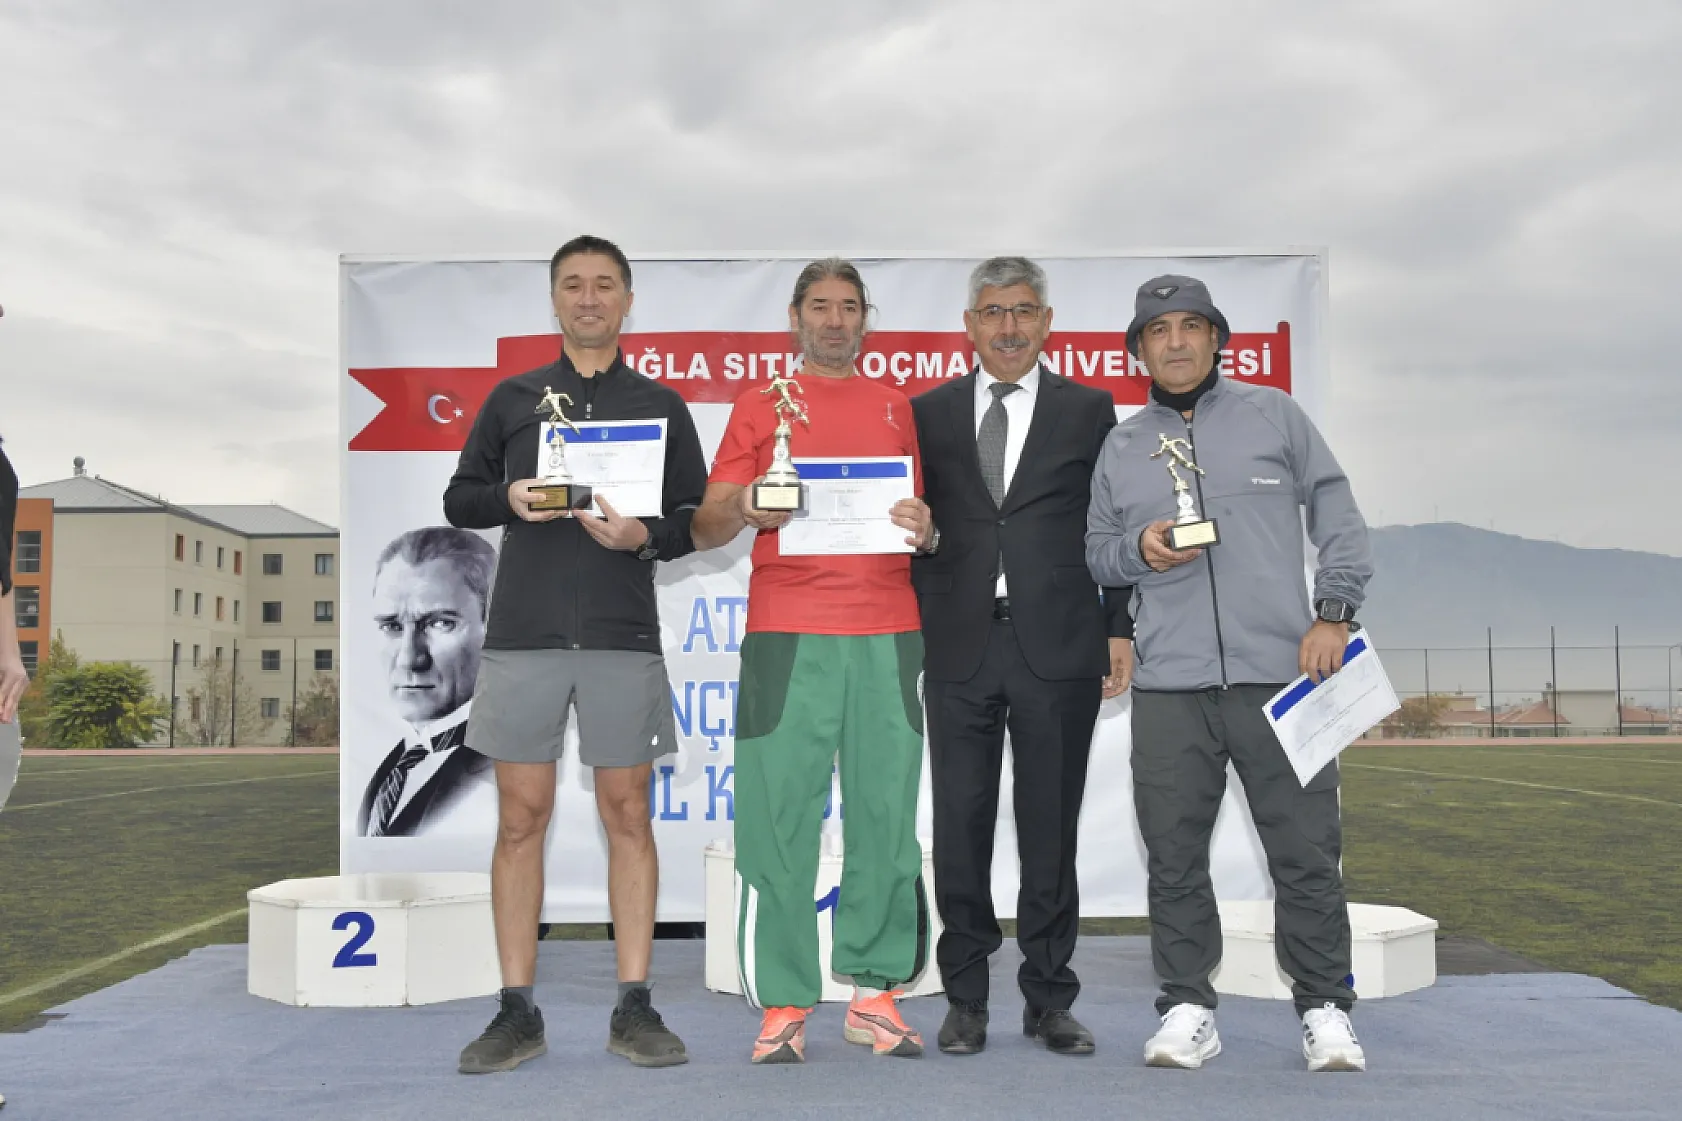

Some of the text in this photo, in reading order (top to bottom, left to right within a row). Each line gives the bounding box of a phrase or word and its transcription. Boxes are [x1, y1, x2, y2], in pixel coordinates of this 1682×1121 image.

[625, 346, 711, 380] ĞLA
[723, 352, 804, 380] SITK
[853, 351, 982, 386] OÇMA
[331, 911, 377, 968] 2
